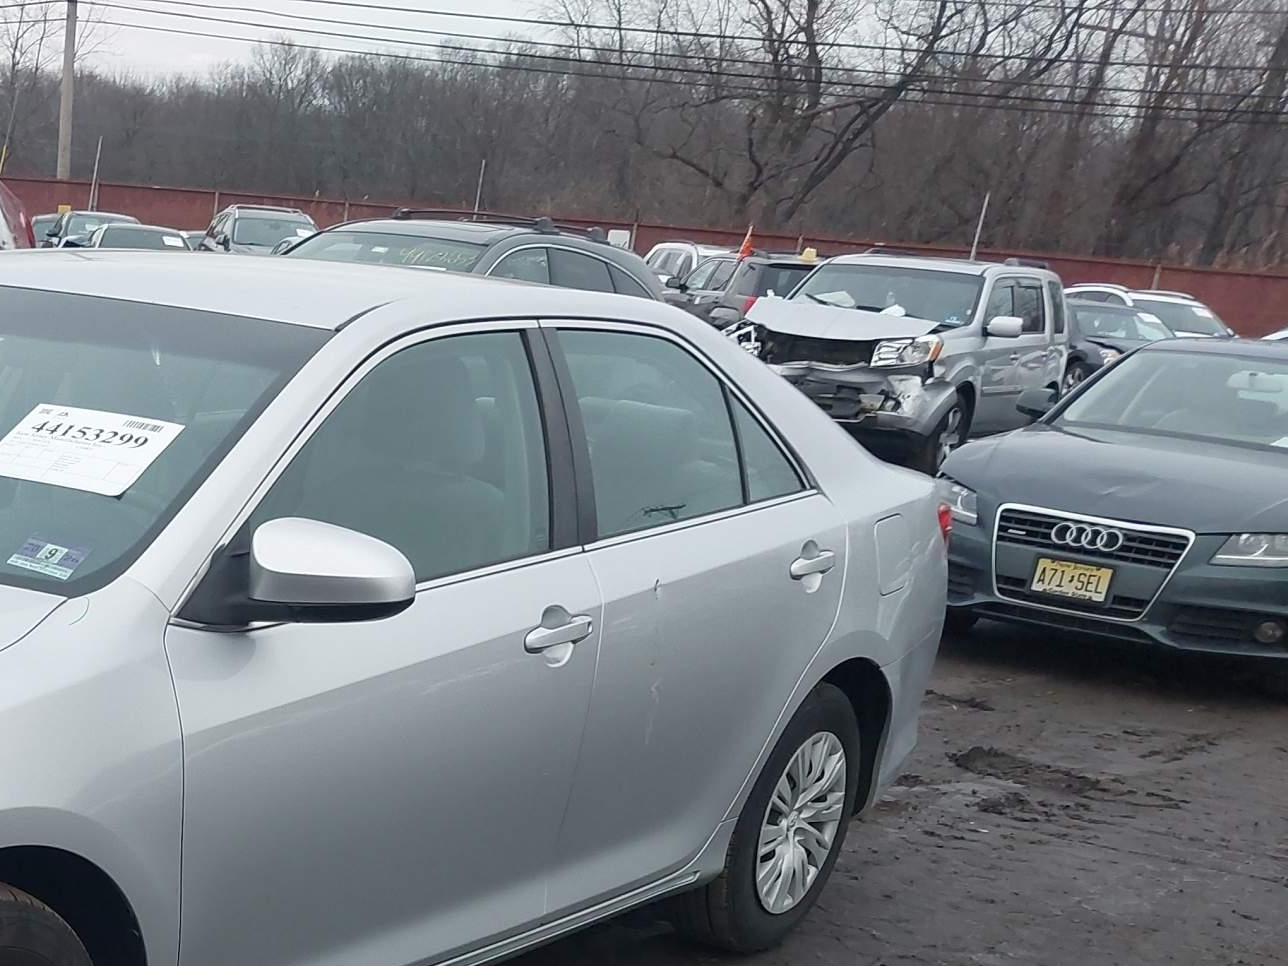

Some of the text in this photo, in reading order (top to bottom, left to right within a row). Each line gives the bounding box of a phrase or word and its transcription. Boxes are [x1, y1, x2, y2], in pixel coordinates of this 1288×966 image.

[31, 420, 149, 449] 44153299
[45, 547, 58, 560] 9
[1036, 567, 1104, 595] A71 SEL
